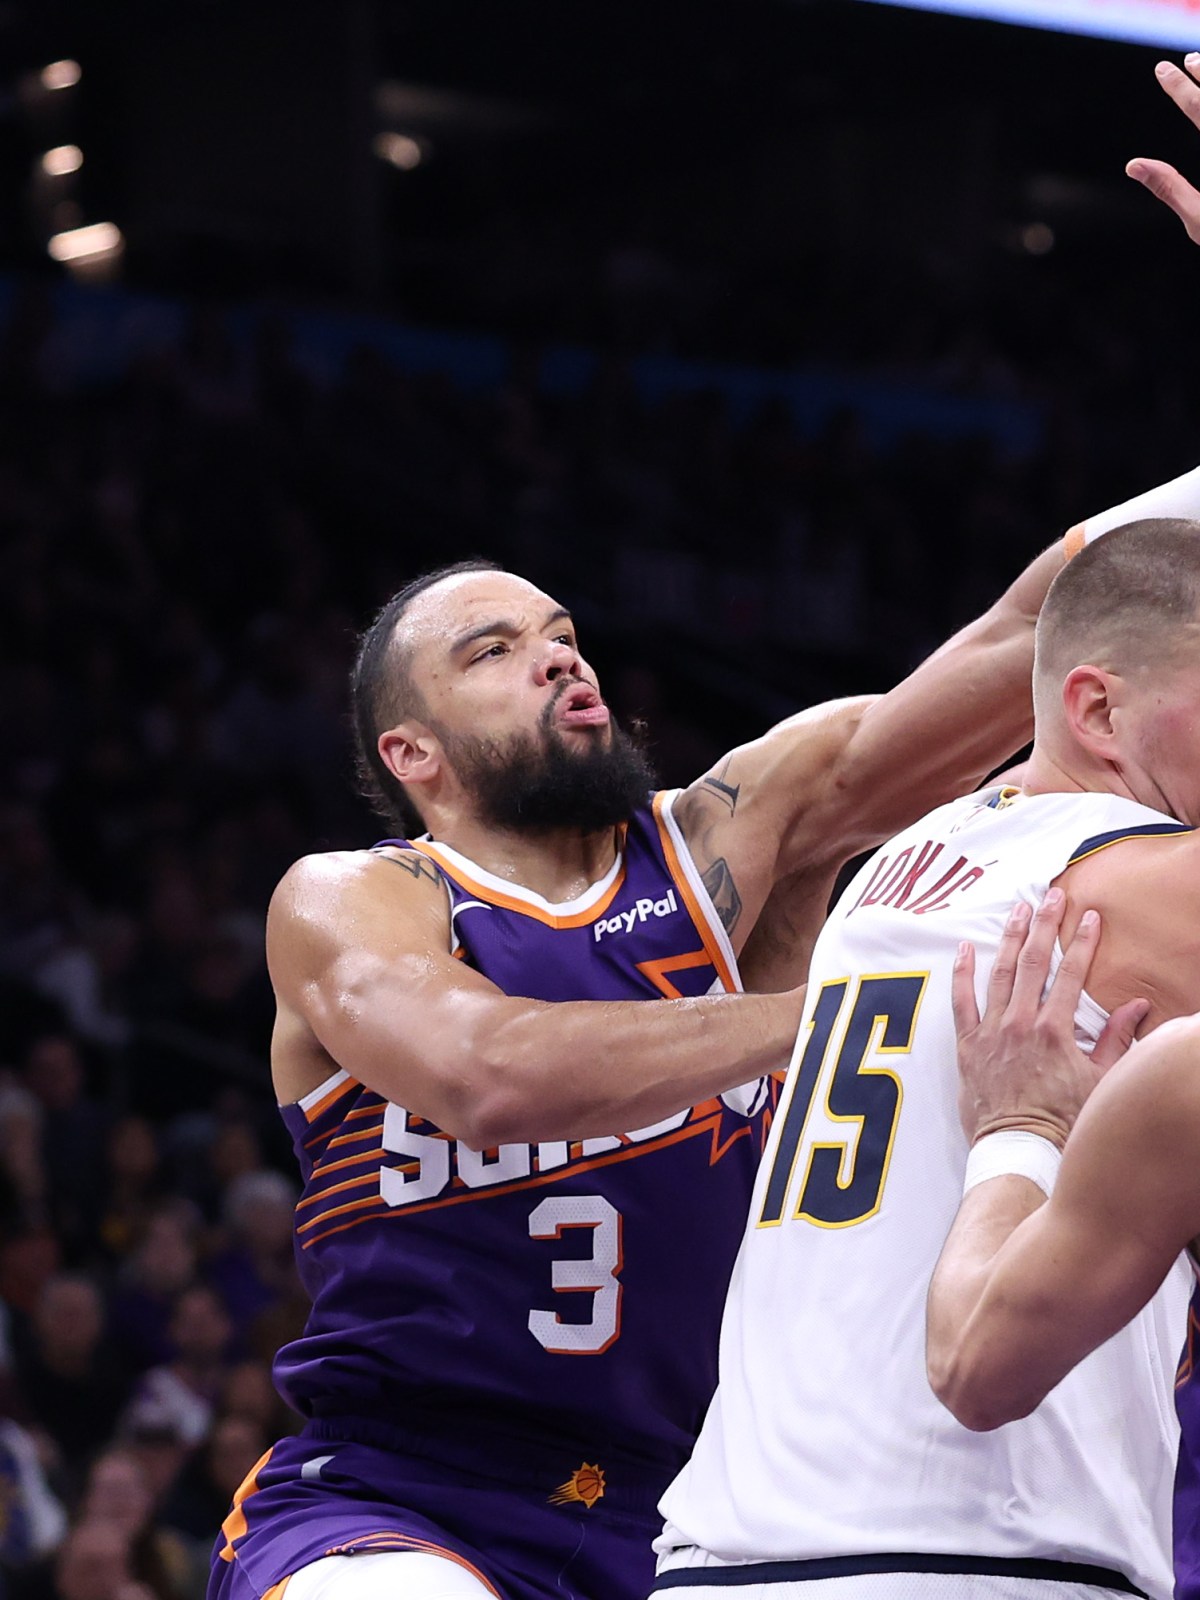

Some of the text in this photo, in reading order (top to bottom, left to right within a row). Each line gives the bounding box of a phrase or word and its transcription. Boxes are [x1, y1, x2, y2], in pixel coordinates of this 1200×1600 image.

[593, 888, 679, 943] PayPal
[755, 970, 930, 1228] 15
[528, 1195, 623, 1355] 3
